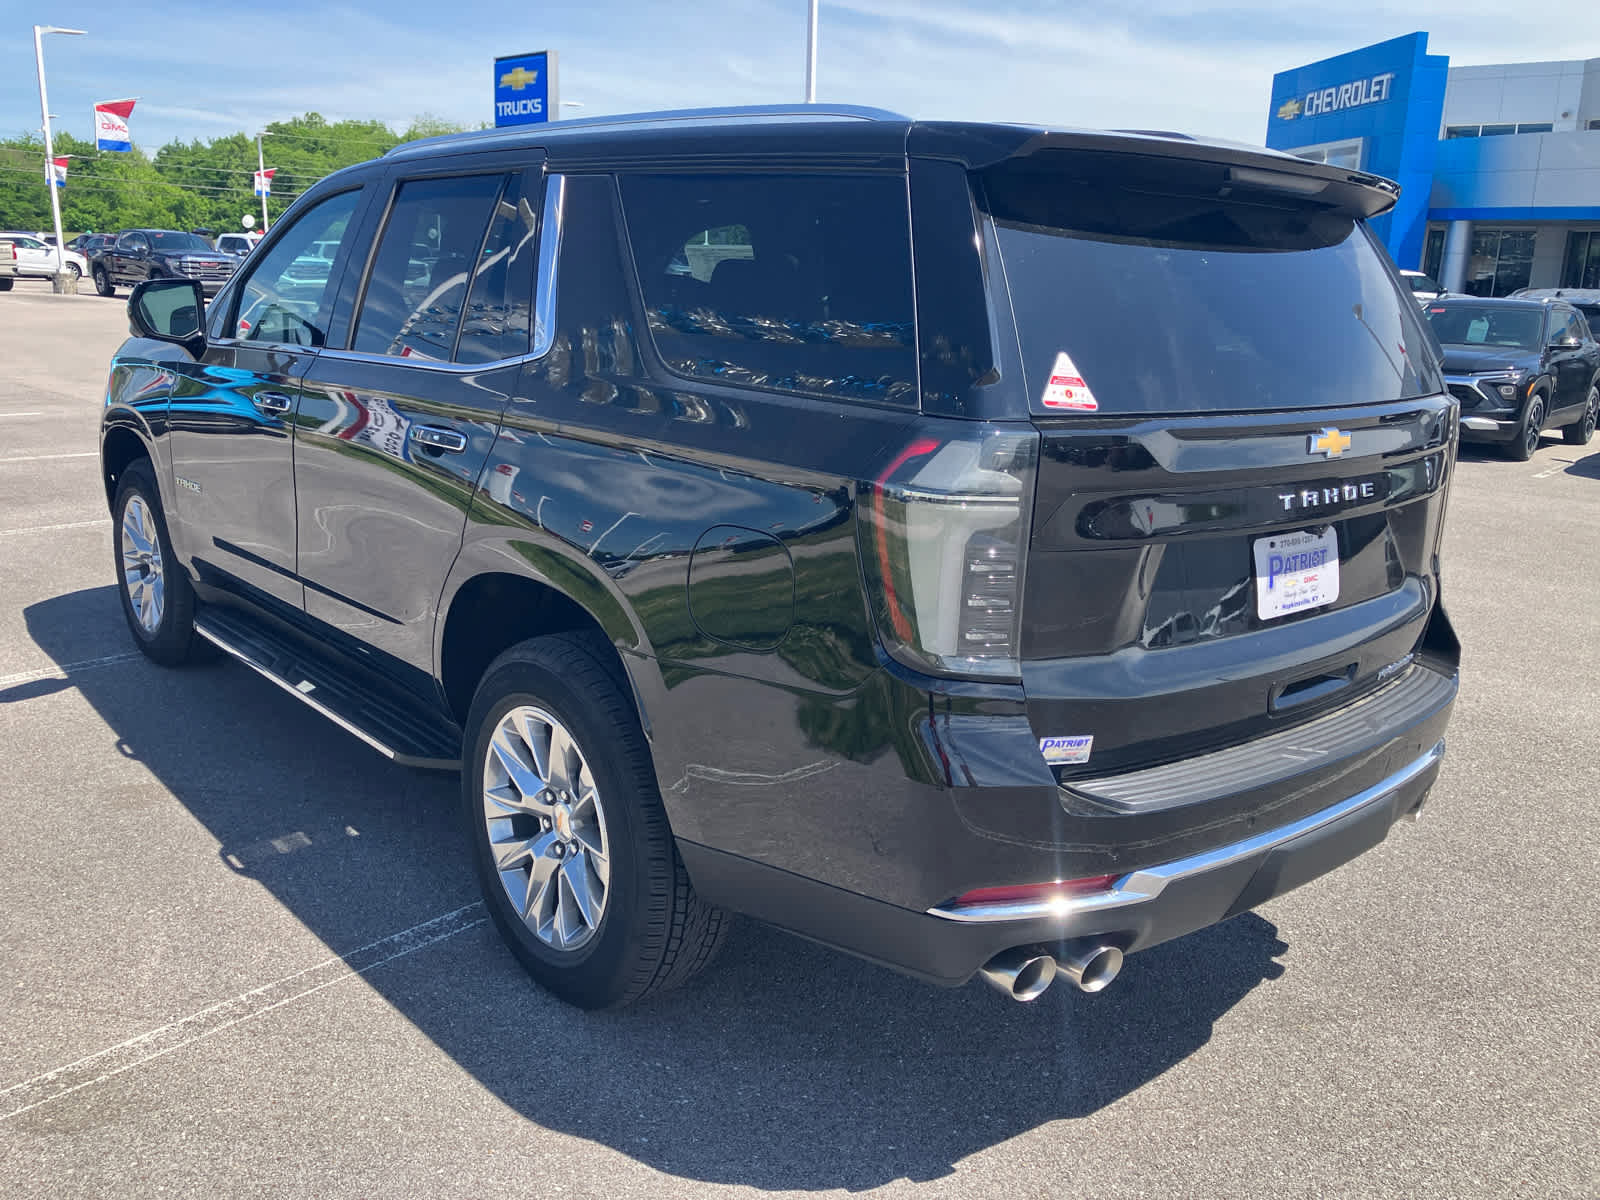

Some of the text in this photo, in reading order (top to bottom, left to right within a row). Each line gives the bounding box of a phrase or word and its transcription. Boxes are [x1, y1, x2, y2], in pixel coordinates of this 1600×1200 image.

[1304, 73, 1392, 116] CHEVROLET
[497, 98, 542, 117] TRUCKS
[1279, 483, 1374, 510] TAHOE
[1269, 549, 1327, 588] PATRIOT
[1303, 574, 1318, 584] GMC
[1041, 739, 1090, 752] PATRIOT
